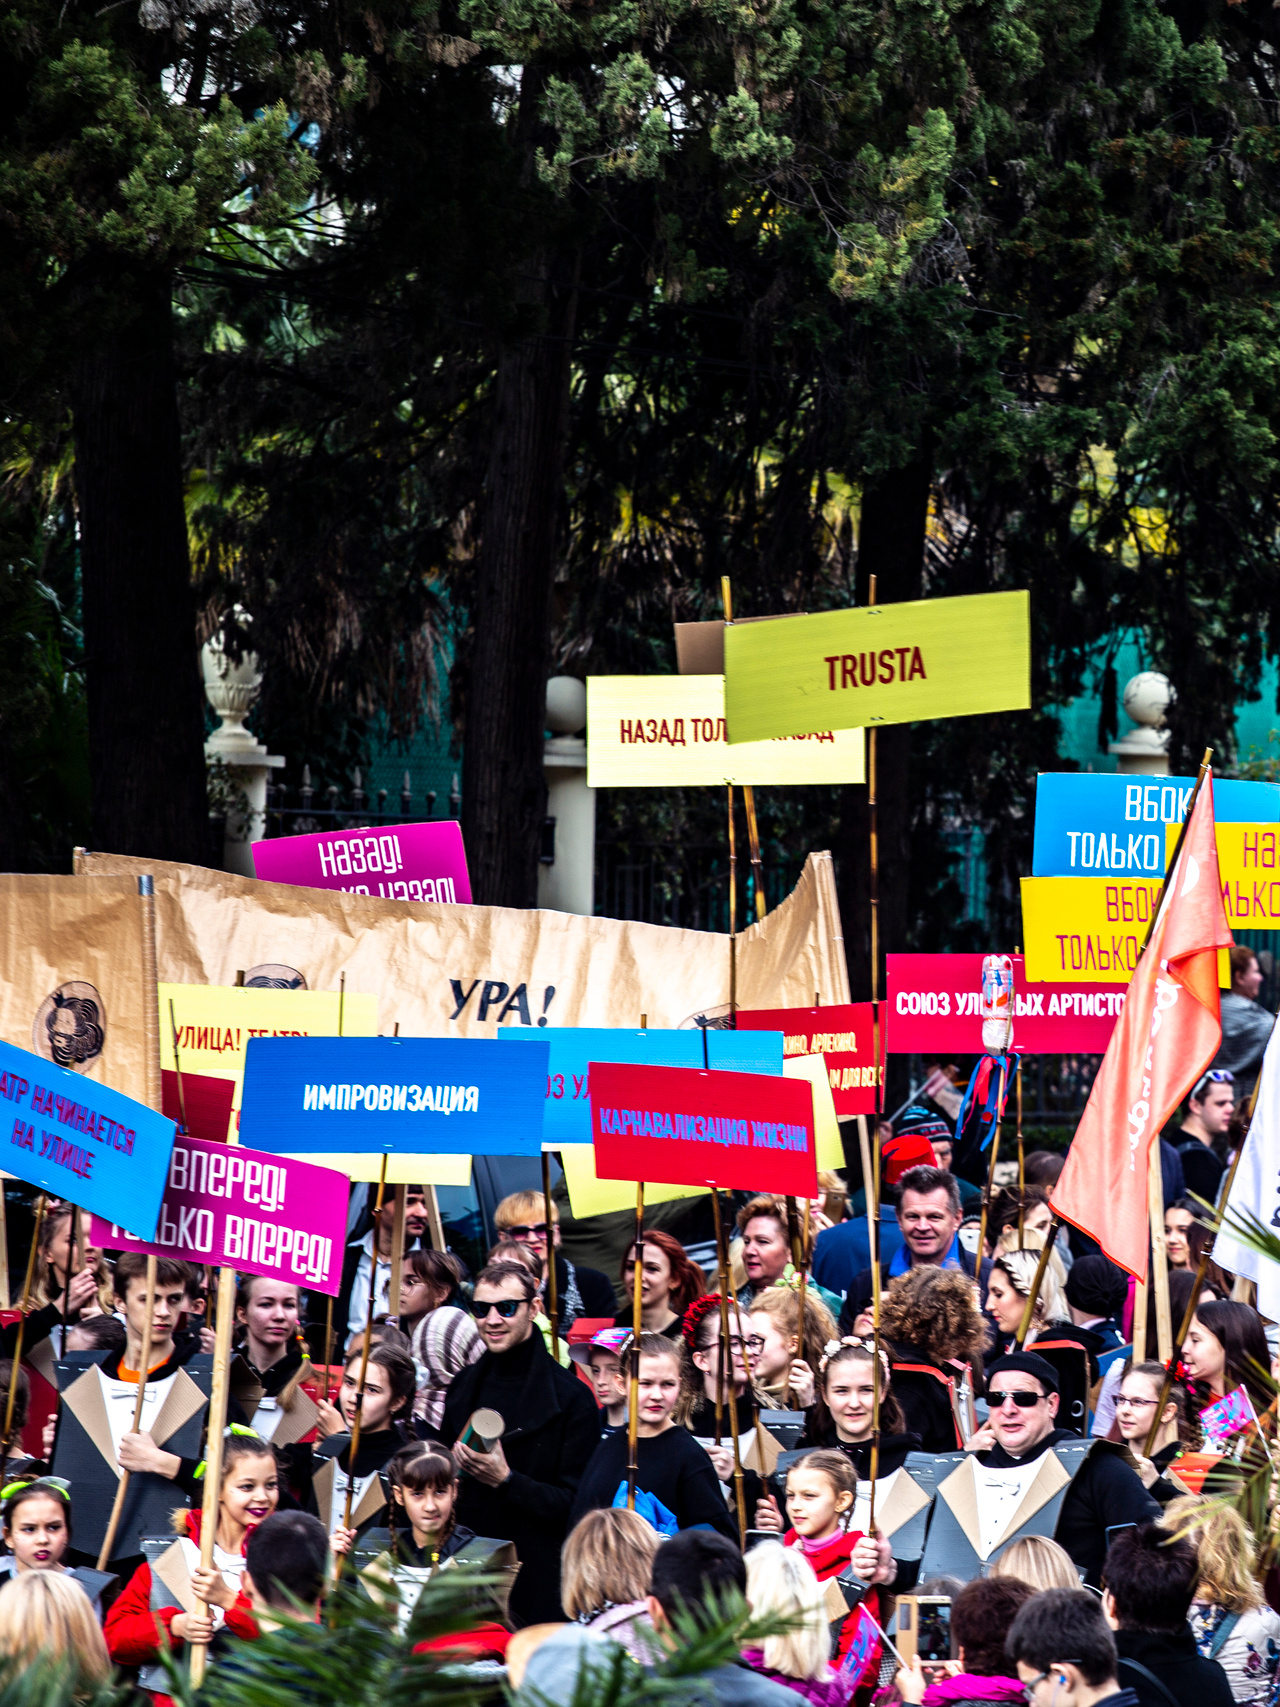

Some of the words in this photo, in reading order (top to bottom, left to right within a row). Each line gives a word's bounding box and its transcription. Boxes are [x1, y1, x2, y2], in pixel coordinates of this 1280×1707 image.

[824, 647, 926, 691] TRUSTA
[620, 718, 686, 746] НАЗАД
[691, 718, 728, 743] ТОЛ
[1067, 831, 1160, 870] ТОЛЬКО
[1055, 934, 1140, 972] ТОЛЬКО
[448, 978, 556, 1028] УРА!
[896, 992, 951, 1016] СОЮЗ
[1047, 992, 1128, 1017] АРТИСТО
[173, 1025, 241, 1054] УЛИЦА!
[0, 1070, 30, 1104] АТР
[31, 1084, 136, 1156] НАЧИНАЕТСЯ
[303, 1084, 479, 1113] ИМПРОВИЗАЦИЯ
[11, 1117, 34, 1152] НА
[38, 1130, 96, 1179] УЛИЦЕ
[600, 1107, 749, 1147] КАРНАВАЛИЗАЦИЯ
[751, 1121, 808, 1152] ЖИЗНИ
